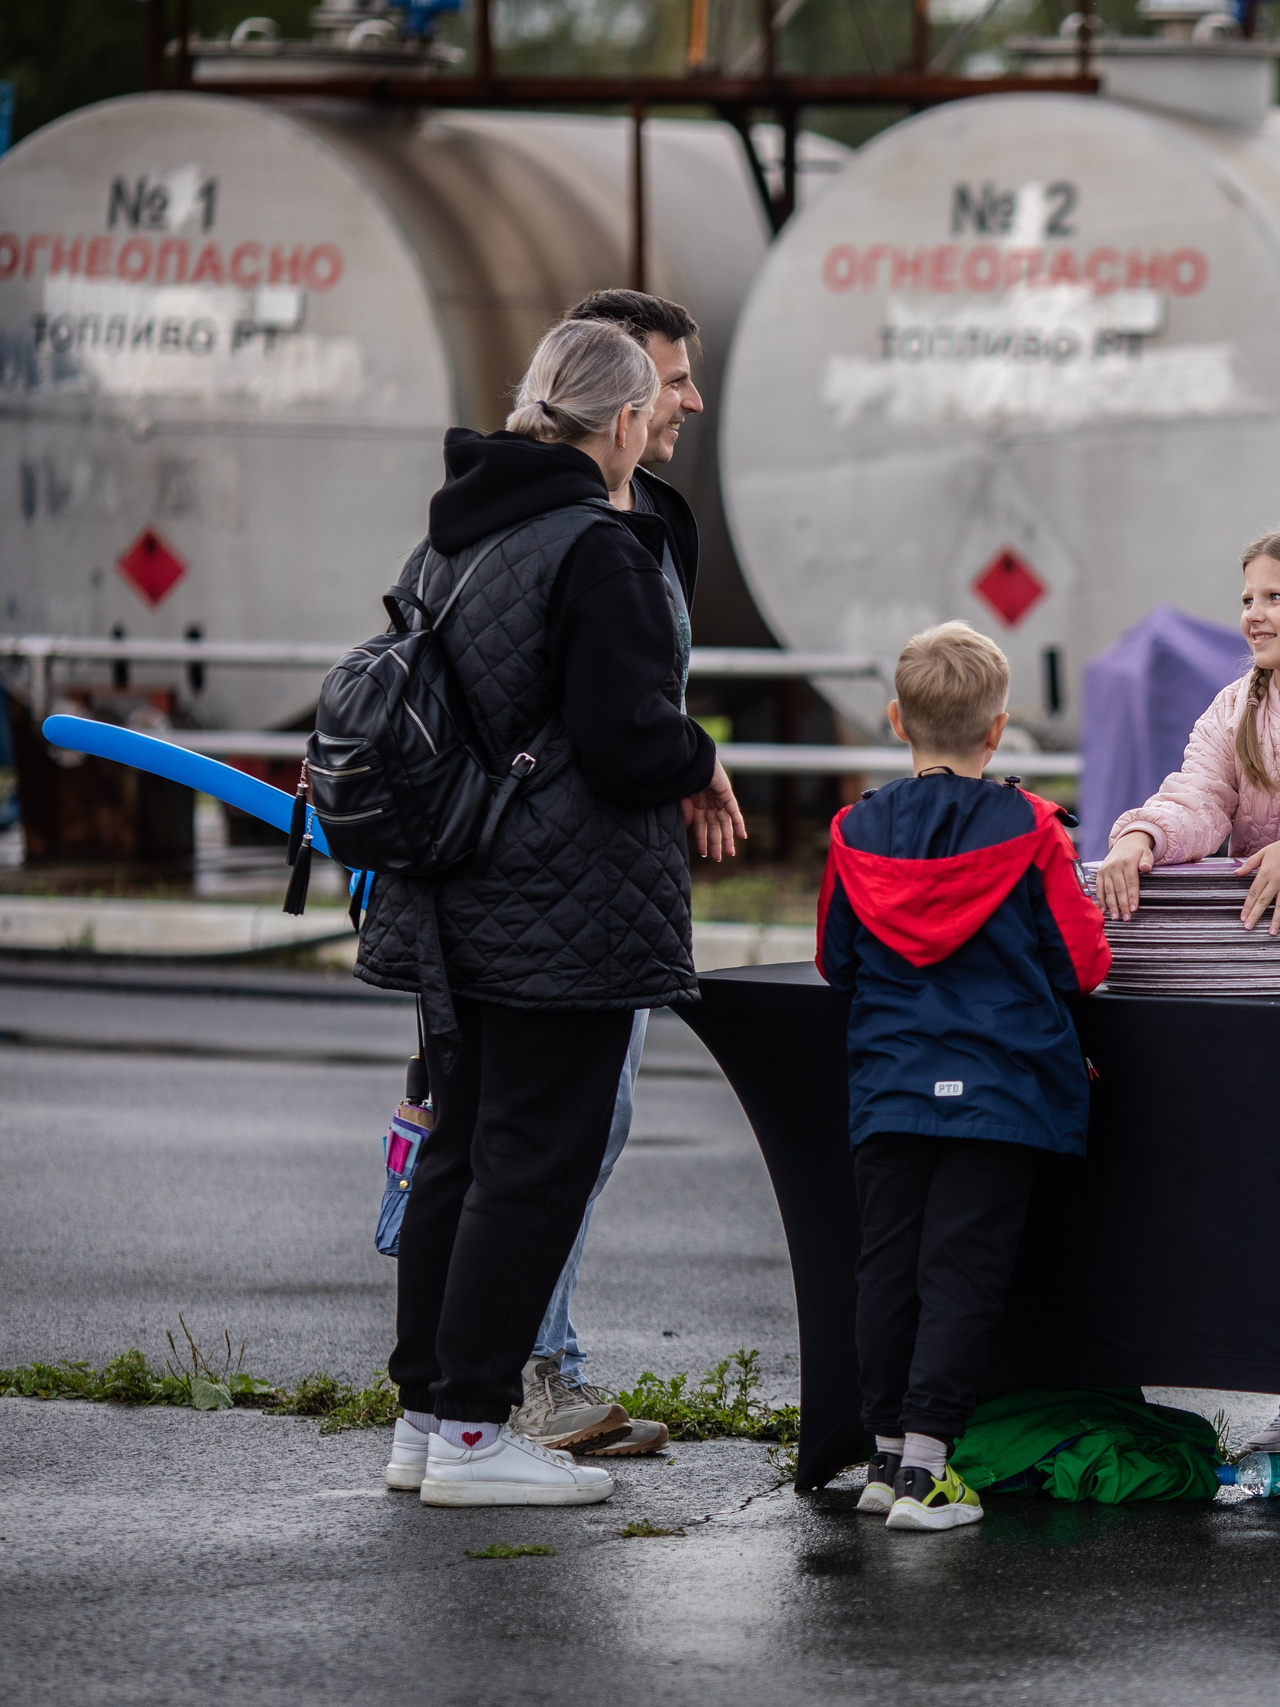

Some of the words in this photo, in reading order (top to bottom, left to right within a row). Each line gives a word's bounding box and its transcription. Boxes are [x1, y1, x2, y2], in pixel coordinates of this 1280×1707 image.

[106, 173, 169, 231] №
[196, 176, 219, 234] 1
[951, 179, 1018, 237] №
[1042, 181, 1080, 238] 2
[821, 243, 1210, 297] ОГНЕОПАСНО
[32, 313, 219, 356] ТОПЛИВО
